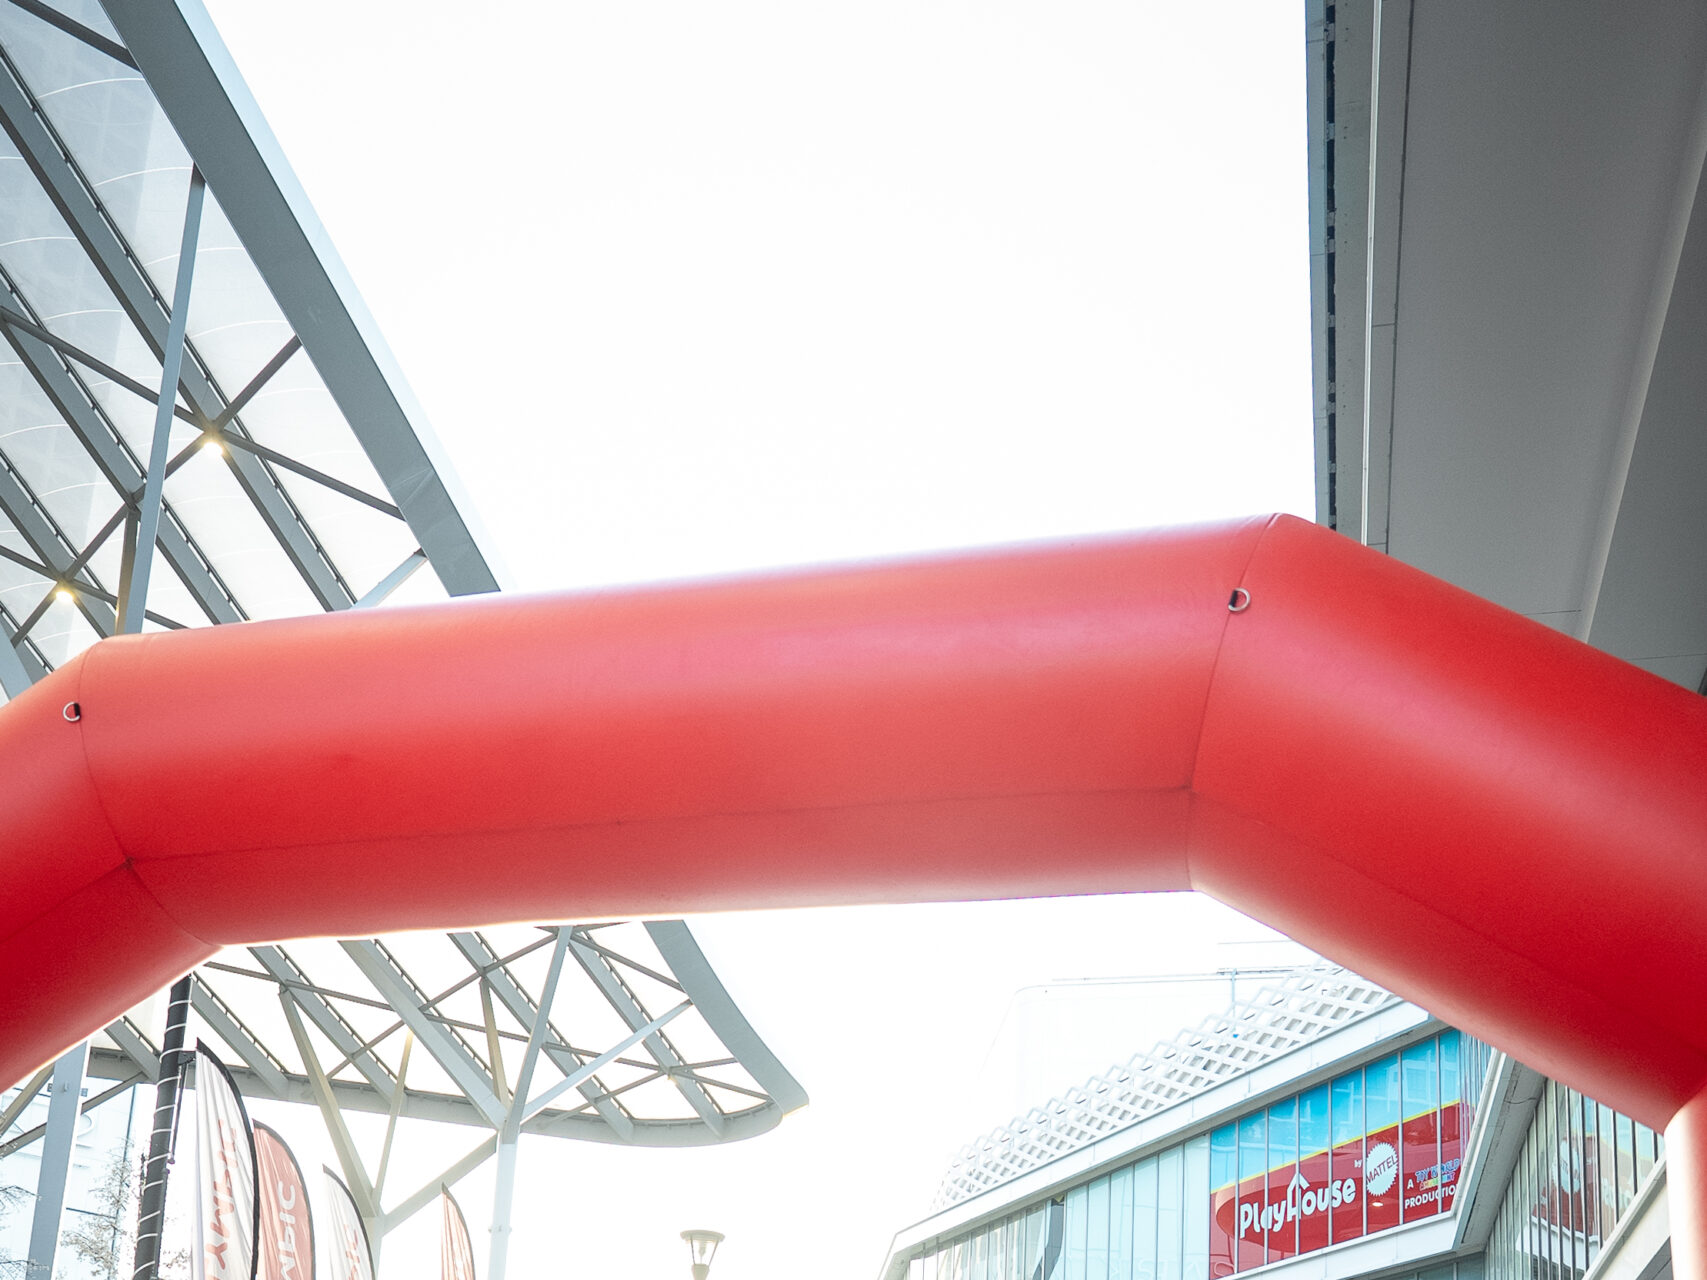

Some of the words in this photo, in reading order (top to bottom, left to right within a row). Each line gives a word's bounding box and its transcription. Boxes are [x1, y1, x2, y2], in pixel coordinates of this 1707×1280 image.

[1366, 1154, 1398, 1185] MATTEL
[1405, 1184, 1458, 1210] PRODUCTIO
[1407, 1179, 1414, 1189] A
